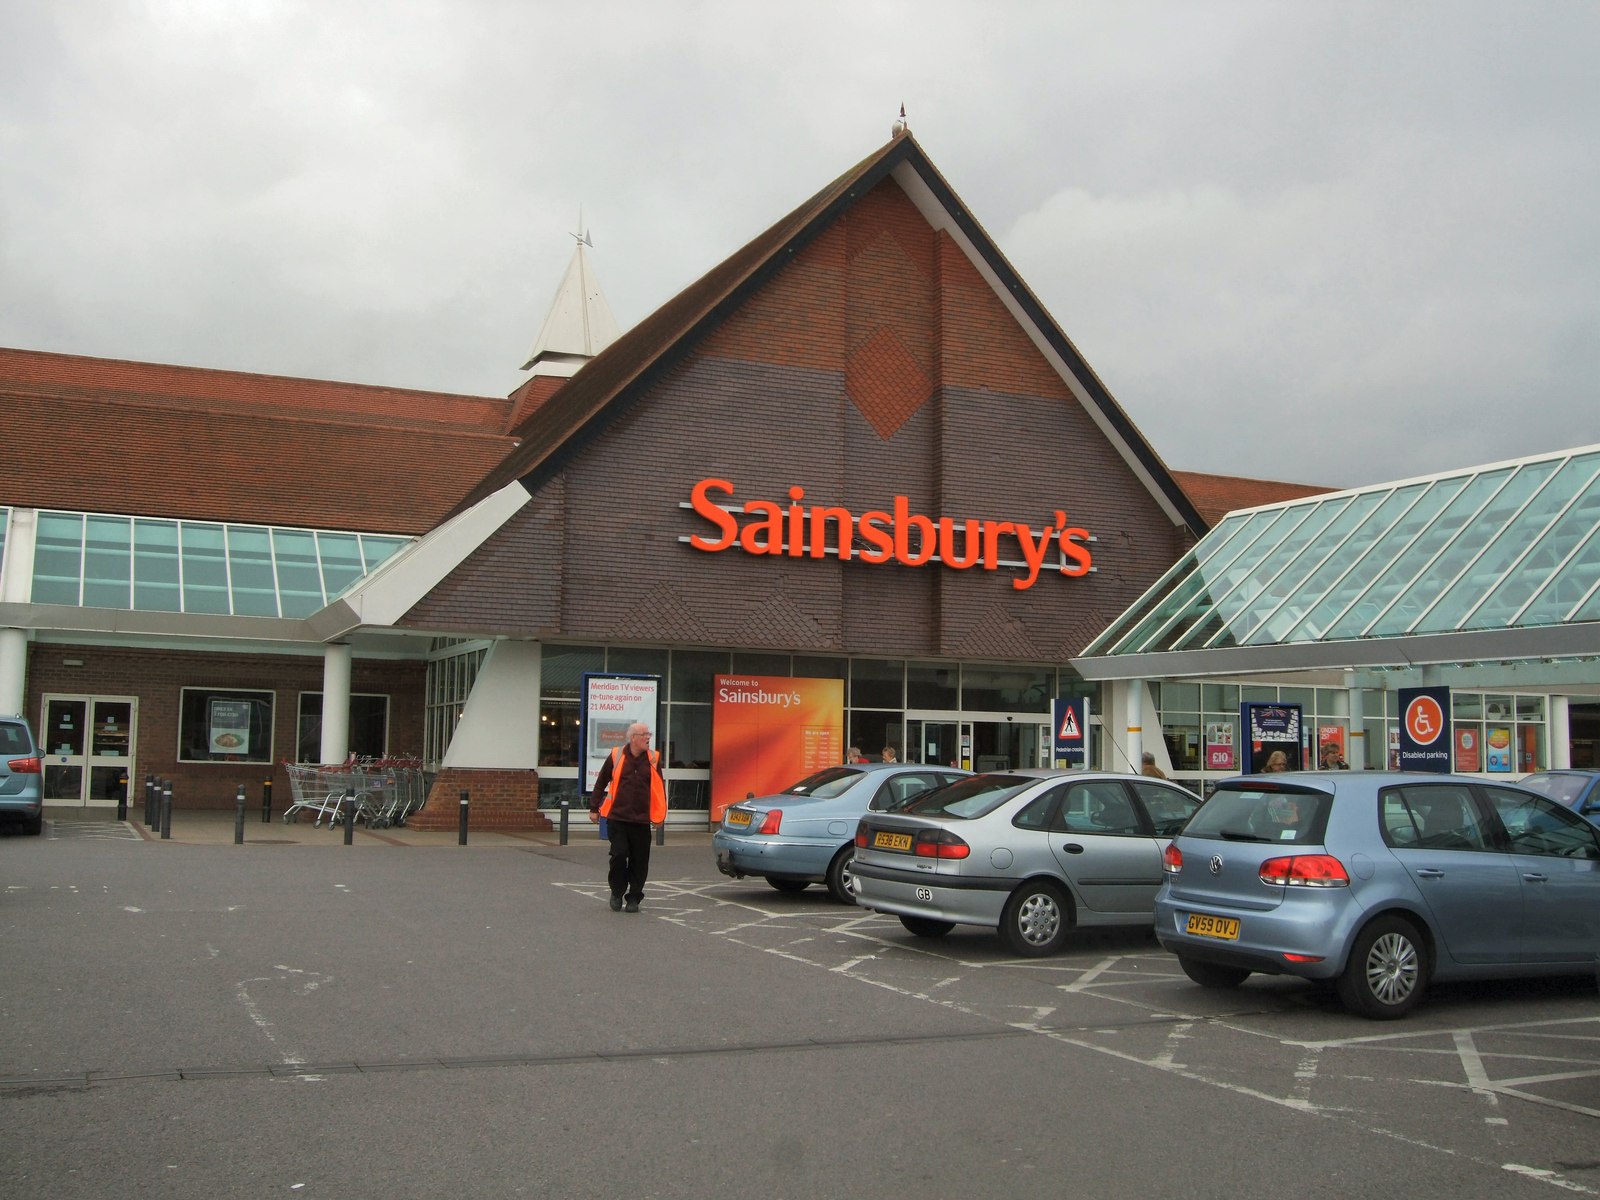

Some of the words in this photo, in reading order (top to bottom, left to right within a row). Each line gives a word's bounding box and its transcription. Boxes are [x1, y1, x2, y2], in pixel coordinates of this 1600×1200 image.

[690, 478, 1092, 590] Sainsbury's
[590, 682, 620, 691] Meridian
[621, 683, 630, 691] TV
[630, 684, 655, 692] viewers
[590, 693, 614, 701] re-tune
[614, 694, 633, 702] again
[719, 688, 801, 708] Sainsbury's
[599, 703, 624, 711] MARCH
[1212, 752, 1229, 763] £10
[1402, 751, 1426, 759] Disabled
[1426, 751, 1448, 760] parking
[876, 832, 894, 847] R538
[893, 834, 909, 848] EKN
[917, 888, 931, 900] GB
[1188, 915, 1214, 932] GV59
[1215, 920, 1238, 936] OVJ
